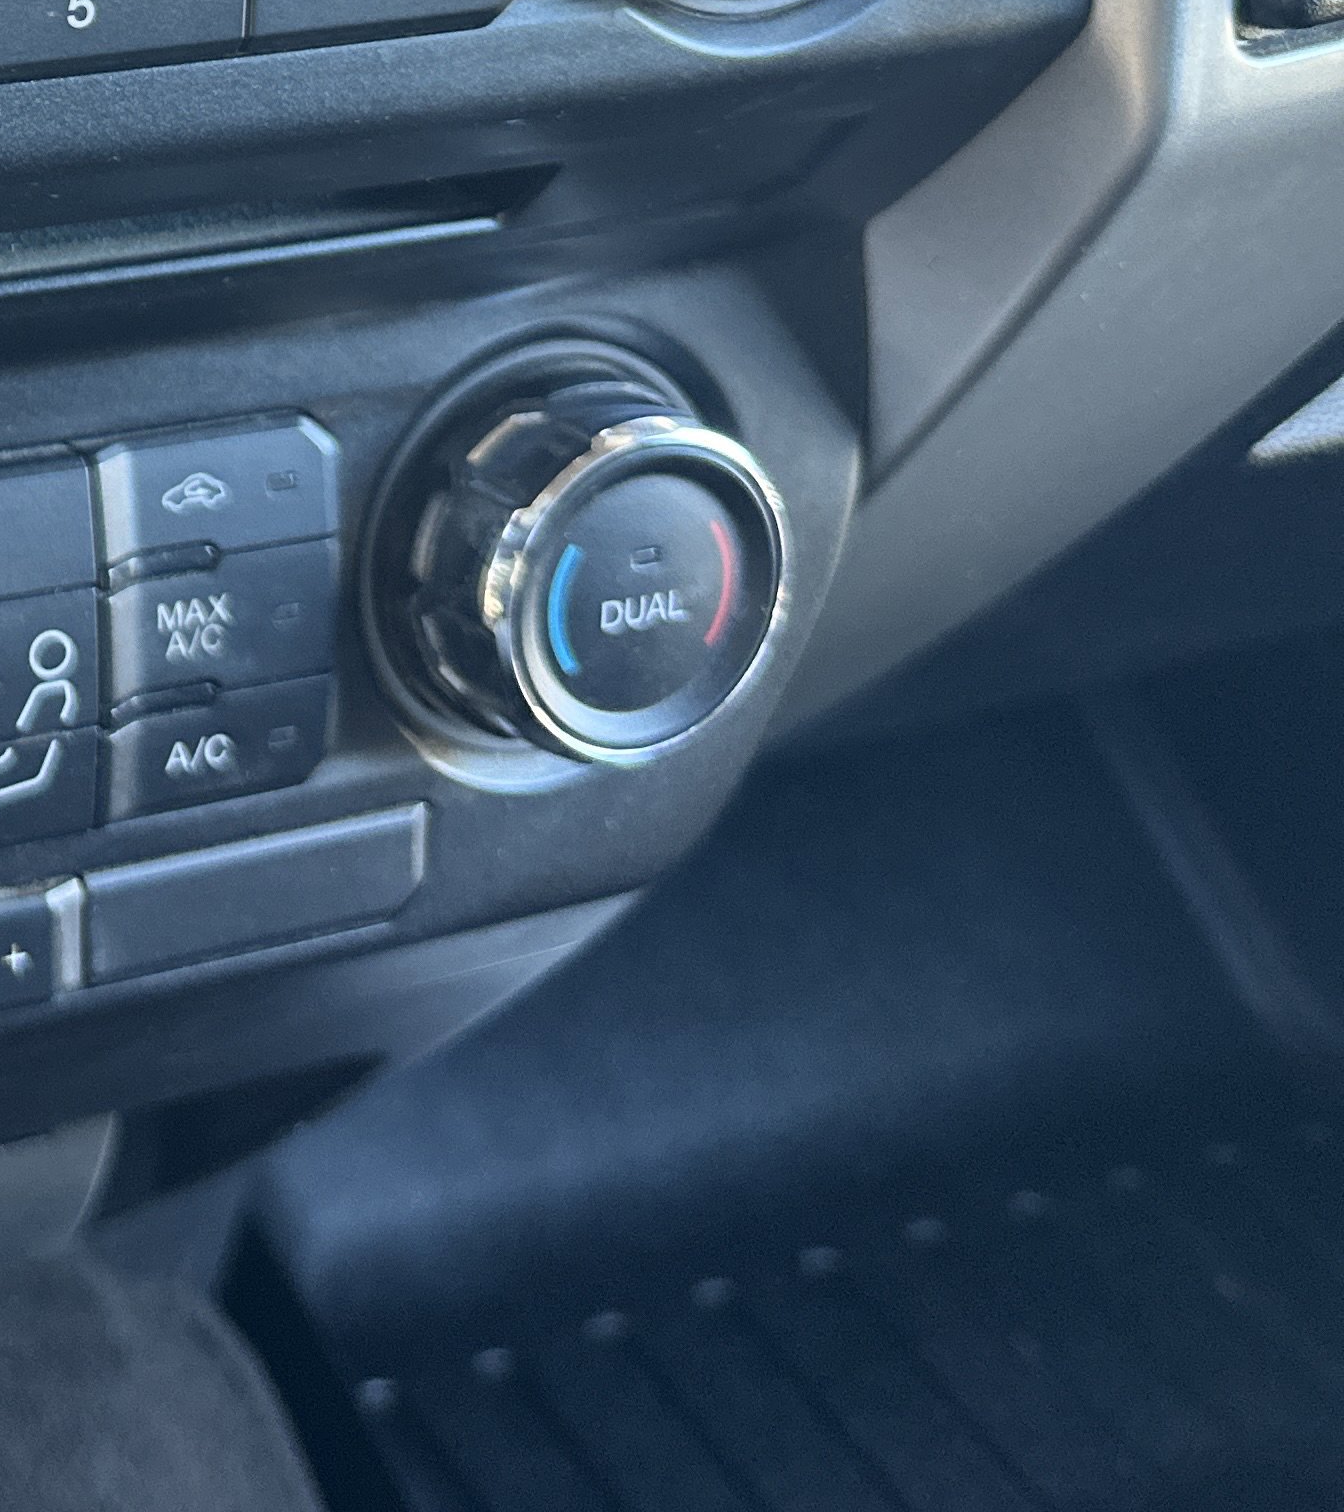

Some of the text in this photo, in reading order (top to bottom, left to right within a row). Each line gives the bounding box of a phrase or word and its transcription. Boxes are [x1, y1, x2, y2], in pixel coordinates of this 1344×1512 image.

[156, 592, 234, 632] MAX
[598, 590, 690, 635] DUAL
[165, 623, 226, 663] A/C
[164, 732, 235, 776] A/C
